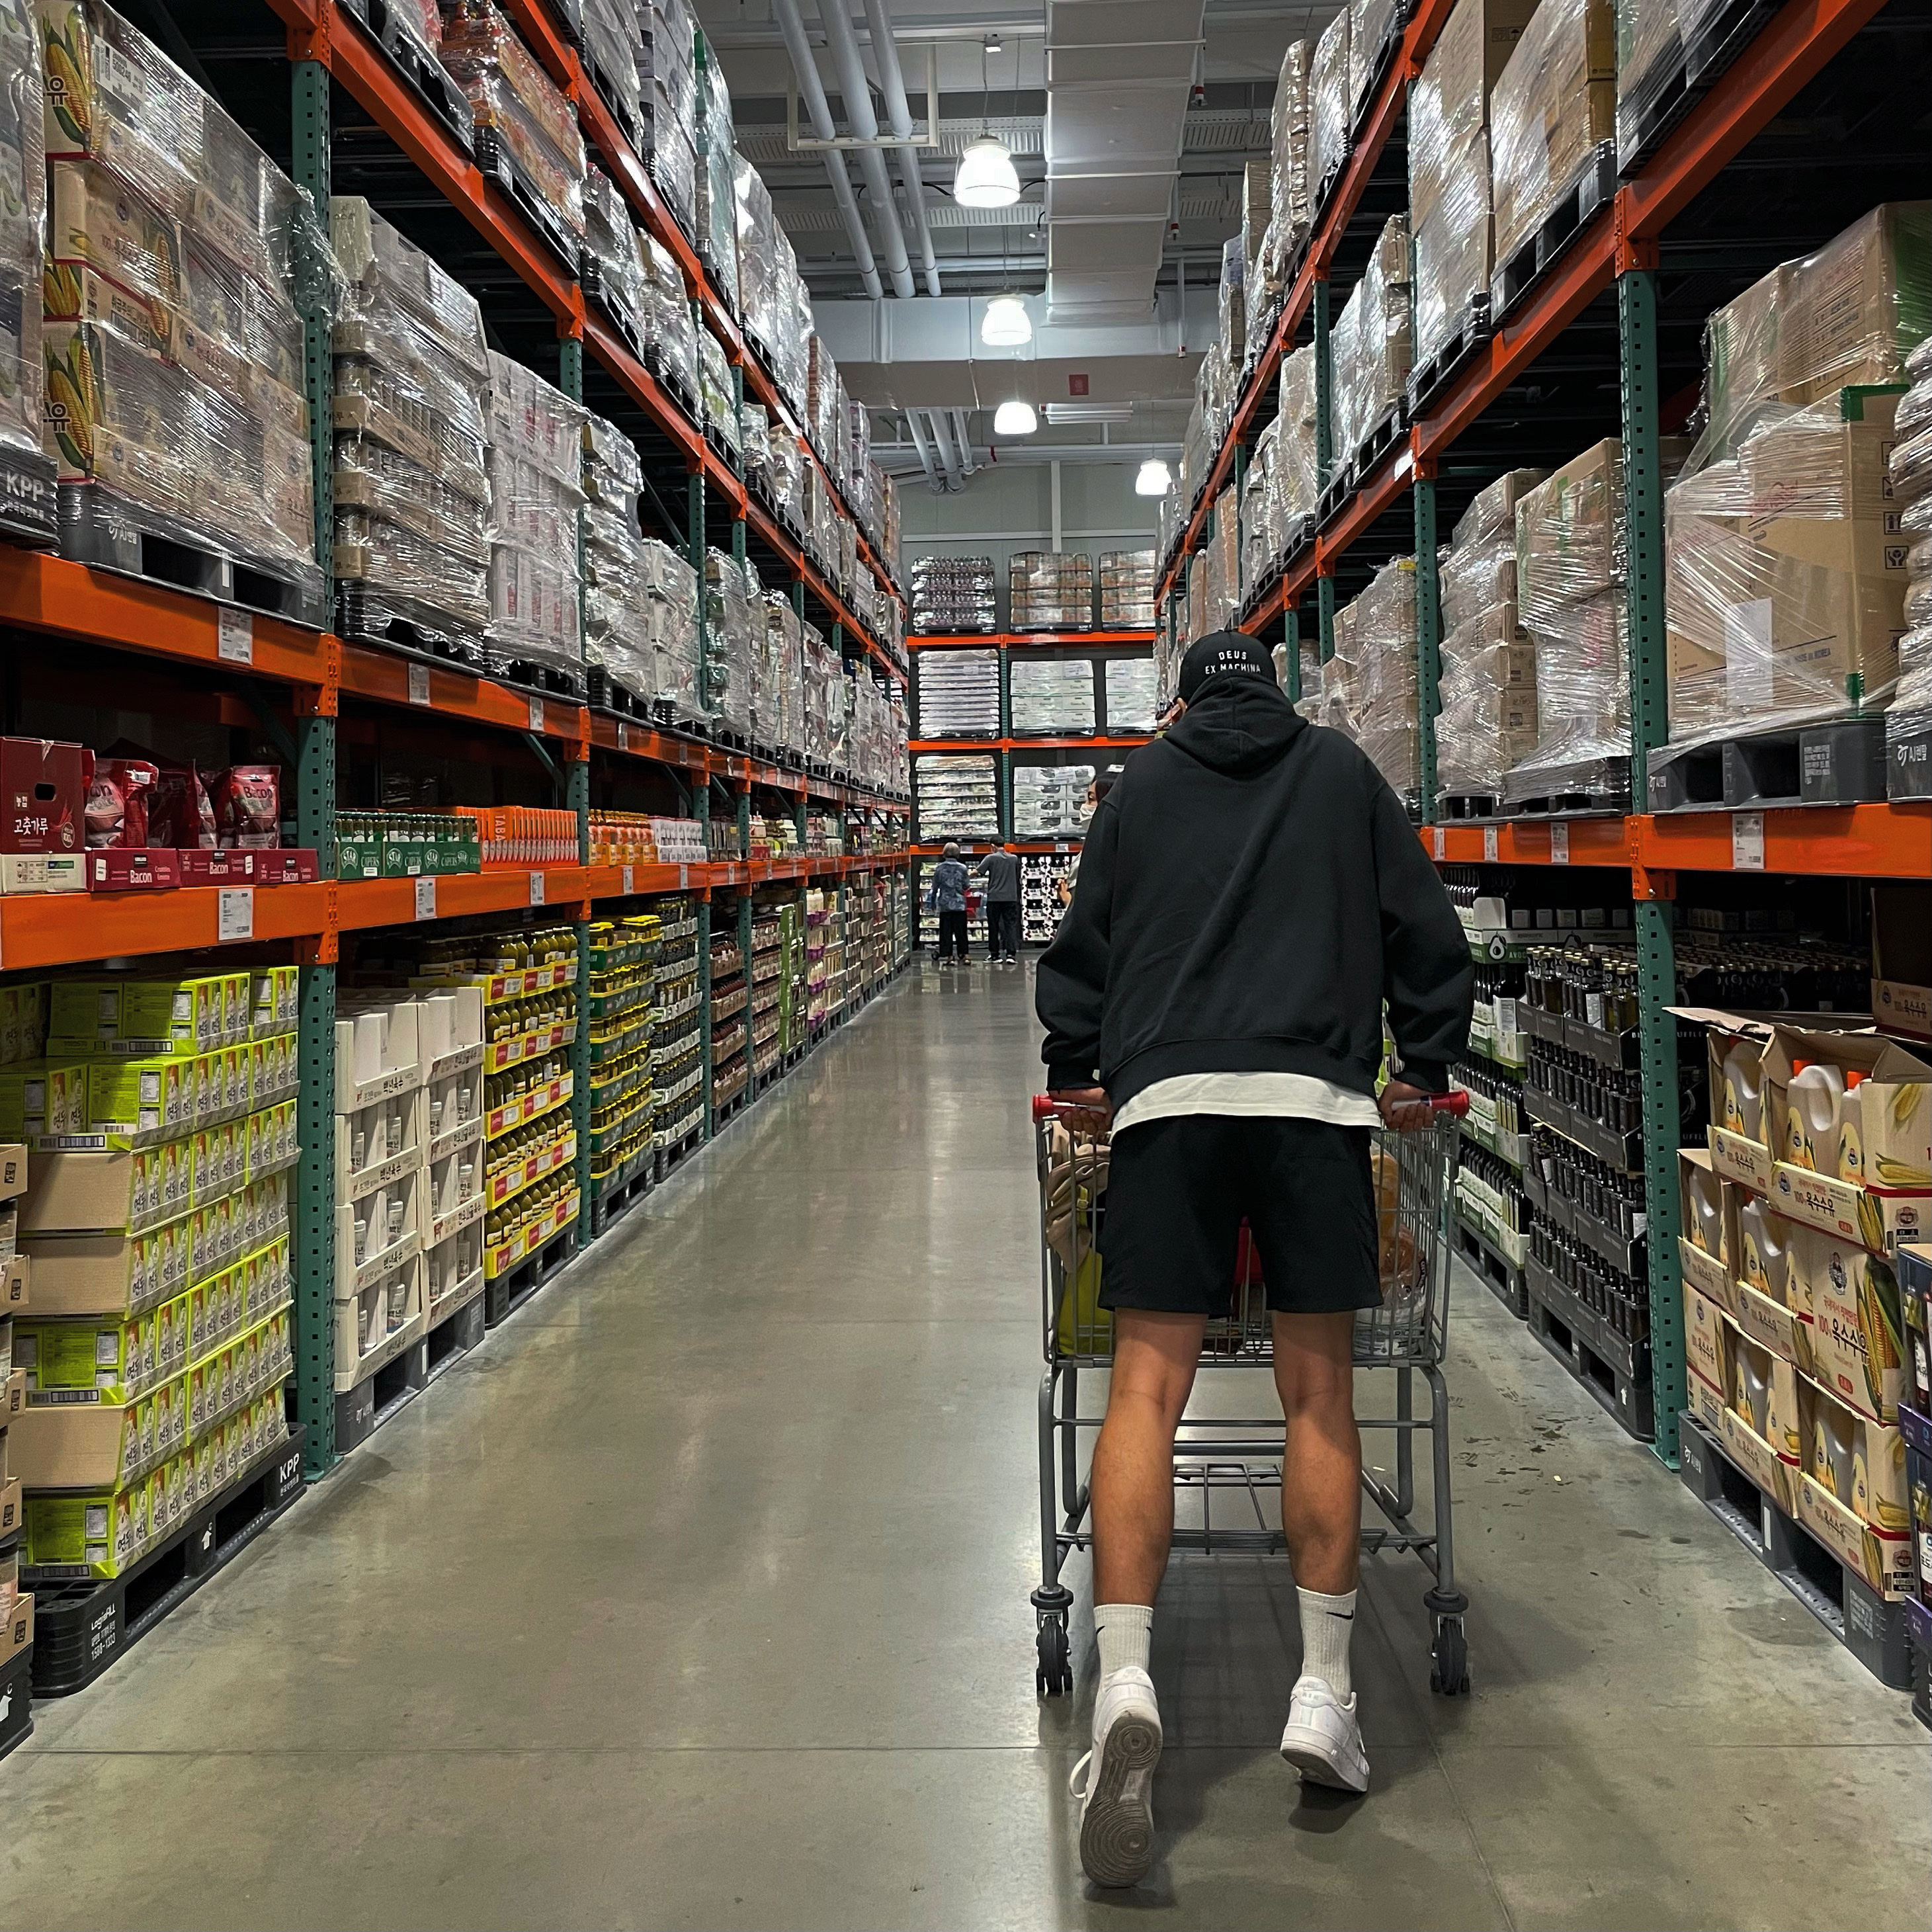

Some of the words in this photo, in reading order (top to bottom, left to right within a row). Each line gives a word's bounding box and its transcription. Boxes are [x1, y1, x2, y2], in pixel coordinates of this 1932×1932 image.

[6, 470, 44, 502] KPP
[1218, 650, 1247, 661] DEUS
[1205, 665, 1216, 675] EX
[1220, 663, 1261, 673] MACHINA
[243, 786, 273, 799] Bacon
[14, 816, 48, 836] 고춧가루
[495, 814, 506, 841] TABA
[130, 870, 153, 884] Bacon
[209, 862, 229, 875] Bacon
[282, 870, 299, 882] Bacon
[1509, 950, 1527, 959] AVOC
[1904, 999, 1927, 1018] 옥수수유
[383, 1075, 403, 1094] 백년육수
[380, 1161, 402, 1181] 백년육수
[1735, 1150, 1755, 1175] 옥수수유
[1806, 1191, 1835, 1218] 옥수수유
[383, 1249, 403, 1270] 백년육수
[1757, 1310, 1779, 1336] 옥수수유
[1698, 1337, 1715, 1365] 옥수수유
[1831, 1318, 1870, 1365] 옥수수유
[280, 1452, 300, 1484] KPP
[1824, 1509, 1846, 1543] 옥수수유
[7, 1683, 13, 1695] C
